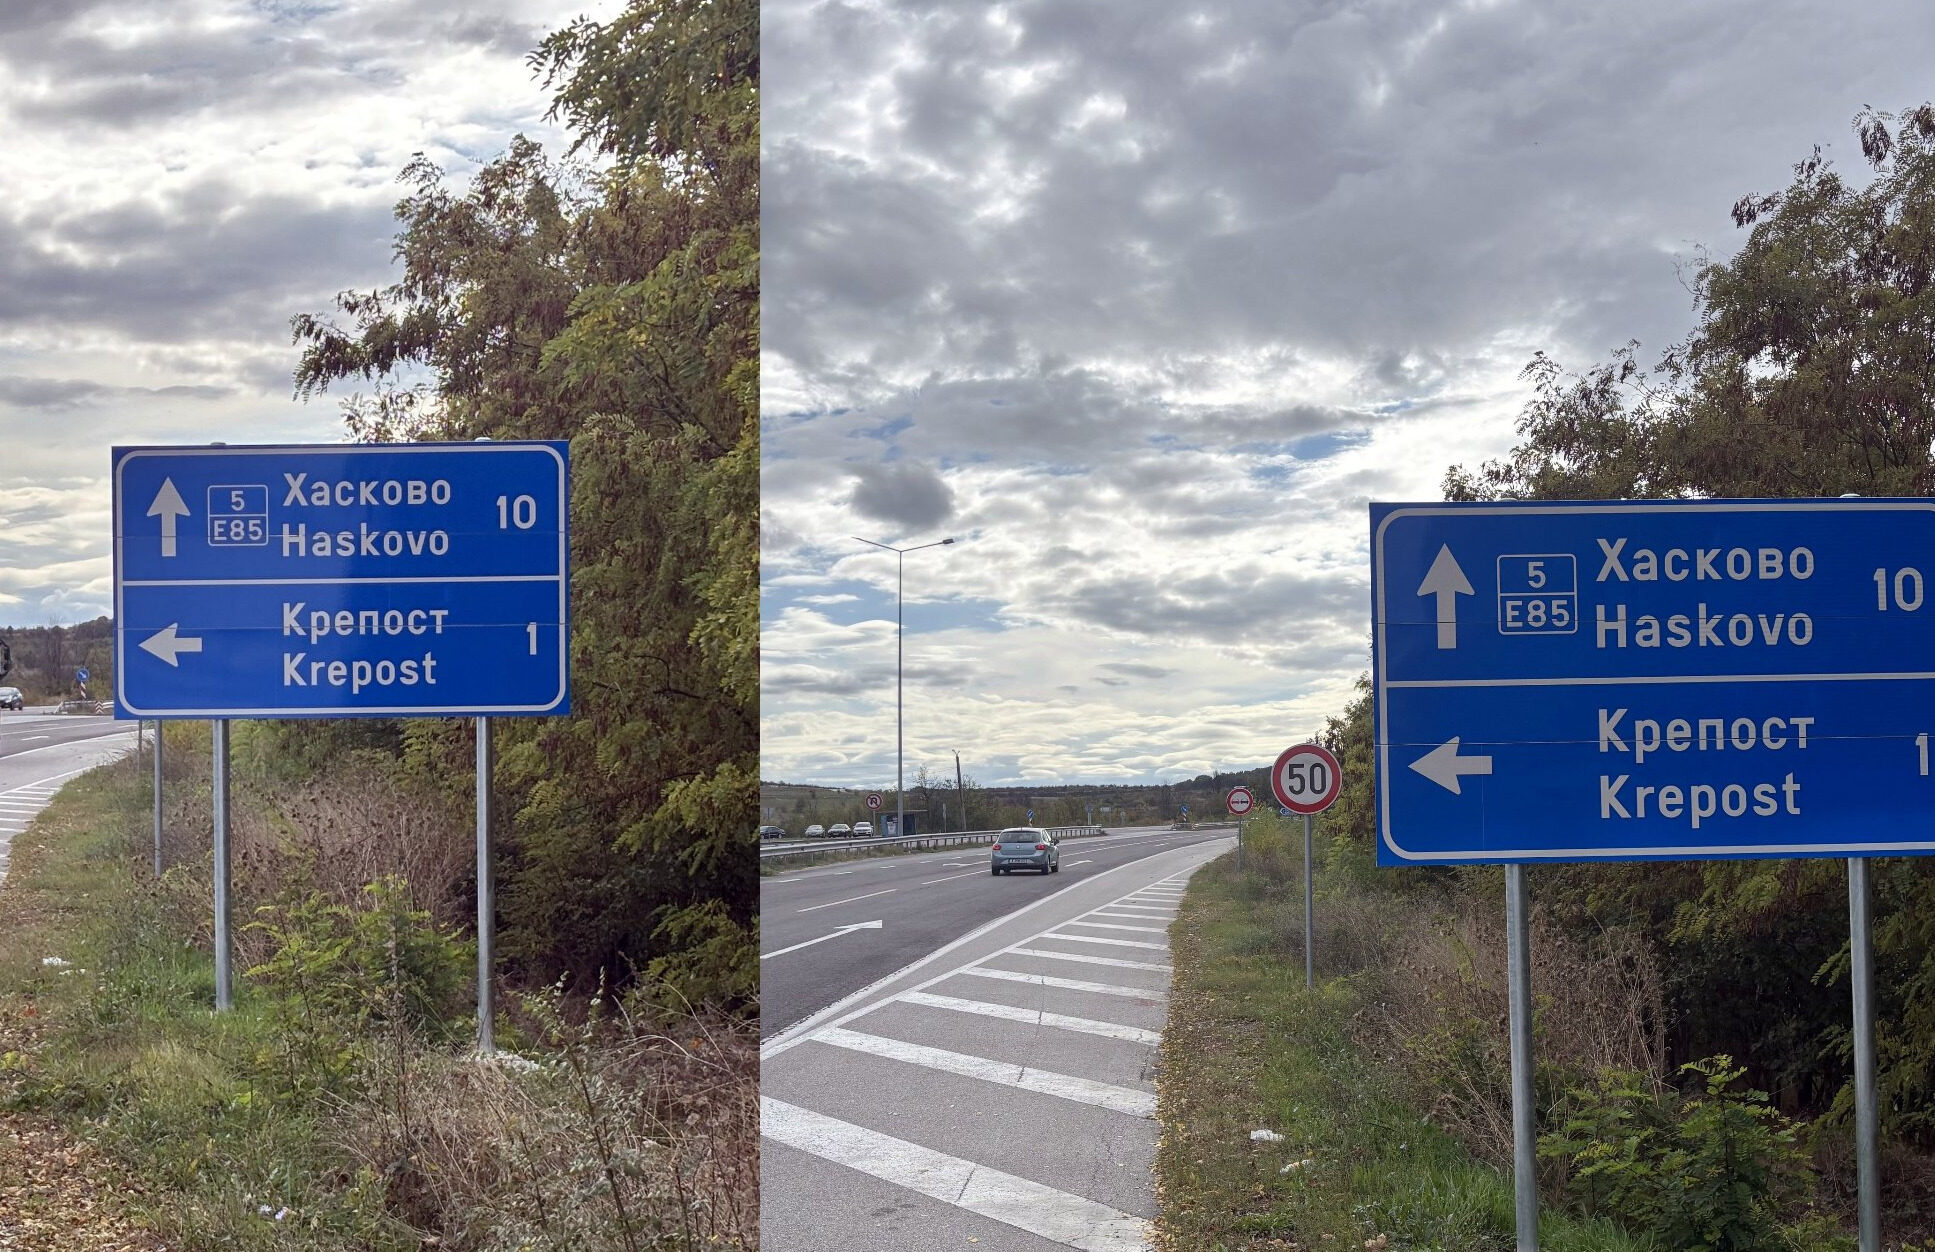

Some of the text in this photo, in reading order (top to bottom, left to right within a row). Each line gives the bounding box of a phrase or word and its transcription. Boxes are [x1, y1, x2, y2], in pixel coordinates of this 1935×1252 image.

[230, 490, 245, 512] 5
[282, 472, 451, 507] Хасково
[496, 494, 537, 530] 10
[213, 520, 263, 541] E85
[282, 522, 450, 557] Haskovo
[1527, 561, 1546, 589] 5
[1596, 537, 1815, 582] Хасково
[1873, 567, 1924, 612] 10
[282, 602, 449, 645] Крепост
[1506, 600, 1570, 628] E85
[1596, 602, 1814, 649] Haskovo
[526, 622, 538, 656] 1
[282, 651, 437, 695] Krepost
[1598, 708, 1815, 764] Крепост
[1915, 733, 1929, 776] 1
[1288, 763, 1326, 795] 50
[1600, 772, 1801, 829] Krepost
